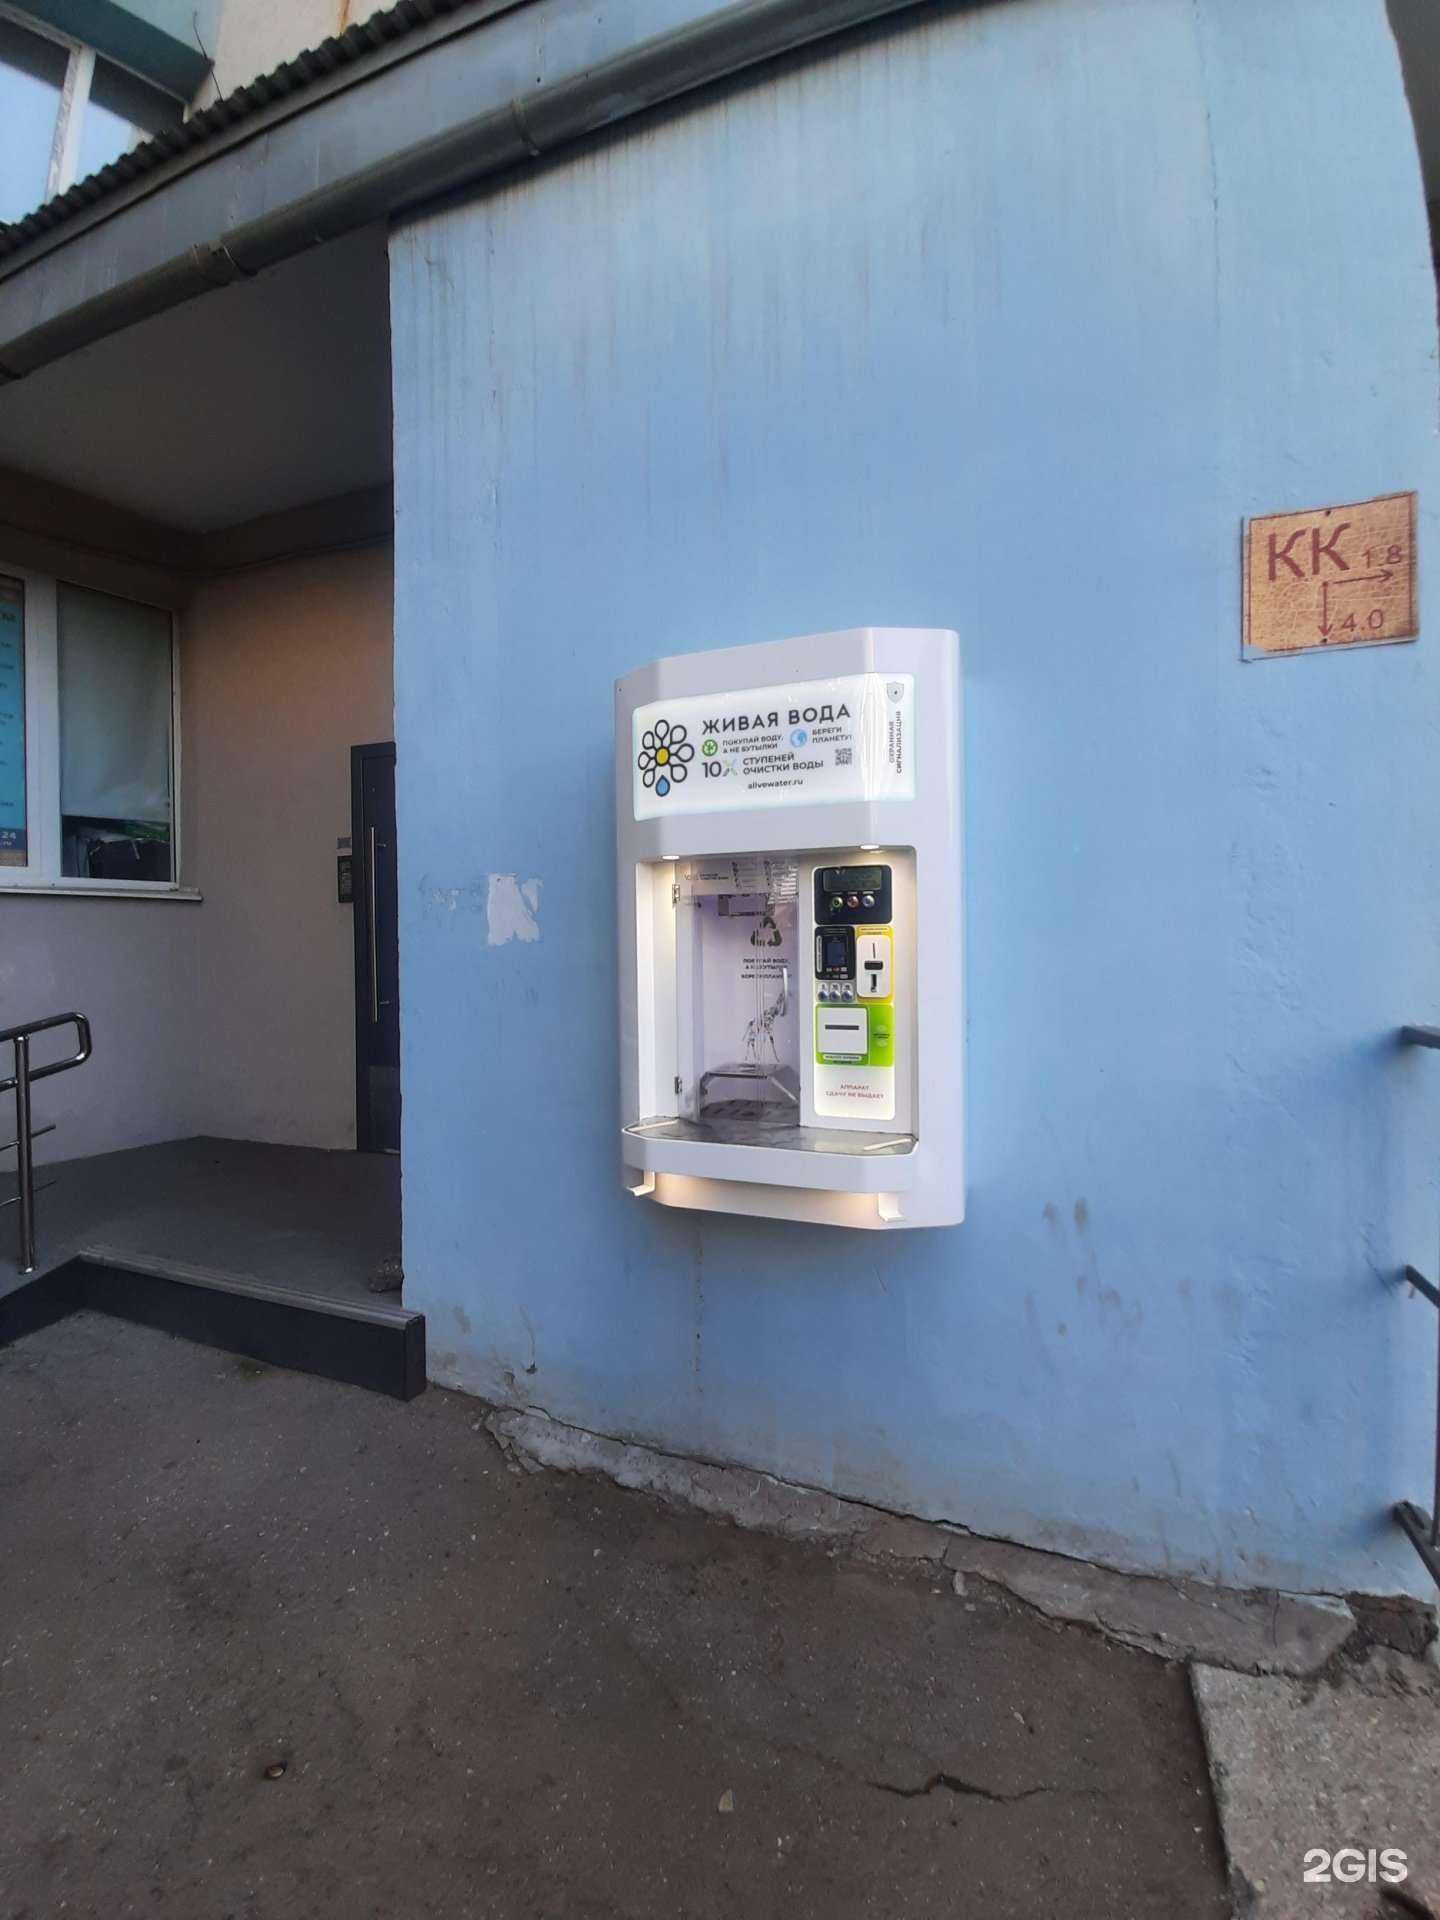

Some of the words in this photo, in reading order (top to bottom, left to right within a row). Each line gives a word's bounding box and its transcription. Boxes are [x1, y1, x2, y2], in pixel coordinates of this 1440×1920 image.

[1268, 522, 1352, 581] КК
[702, 712, 779, 735] ЖИВАЯ
[788, 704, 851, 725] ВОДА
[812, 726, 842, 736] БЕРЕГИ
[722, 736, 760, 747] ПОКУПАЙ
[741, 743, 778, 752] БУТЫЛКИ
[743, 752, 795, 766] СТУПЕНЕЙ
[743, 762, 790, 775] ОЧИСТКИ
[792, 760, 824, 771] ВОДЫ
[748, 779, 804, 790] alivewater.ru
